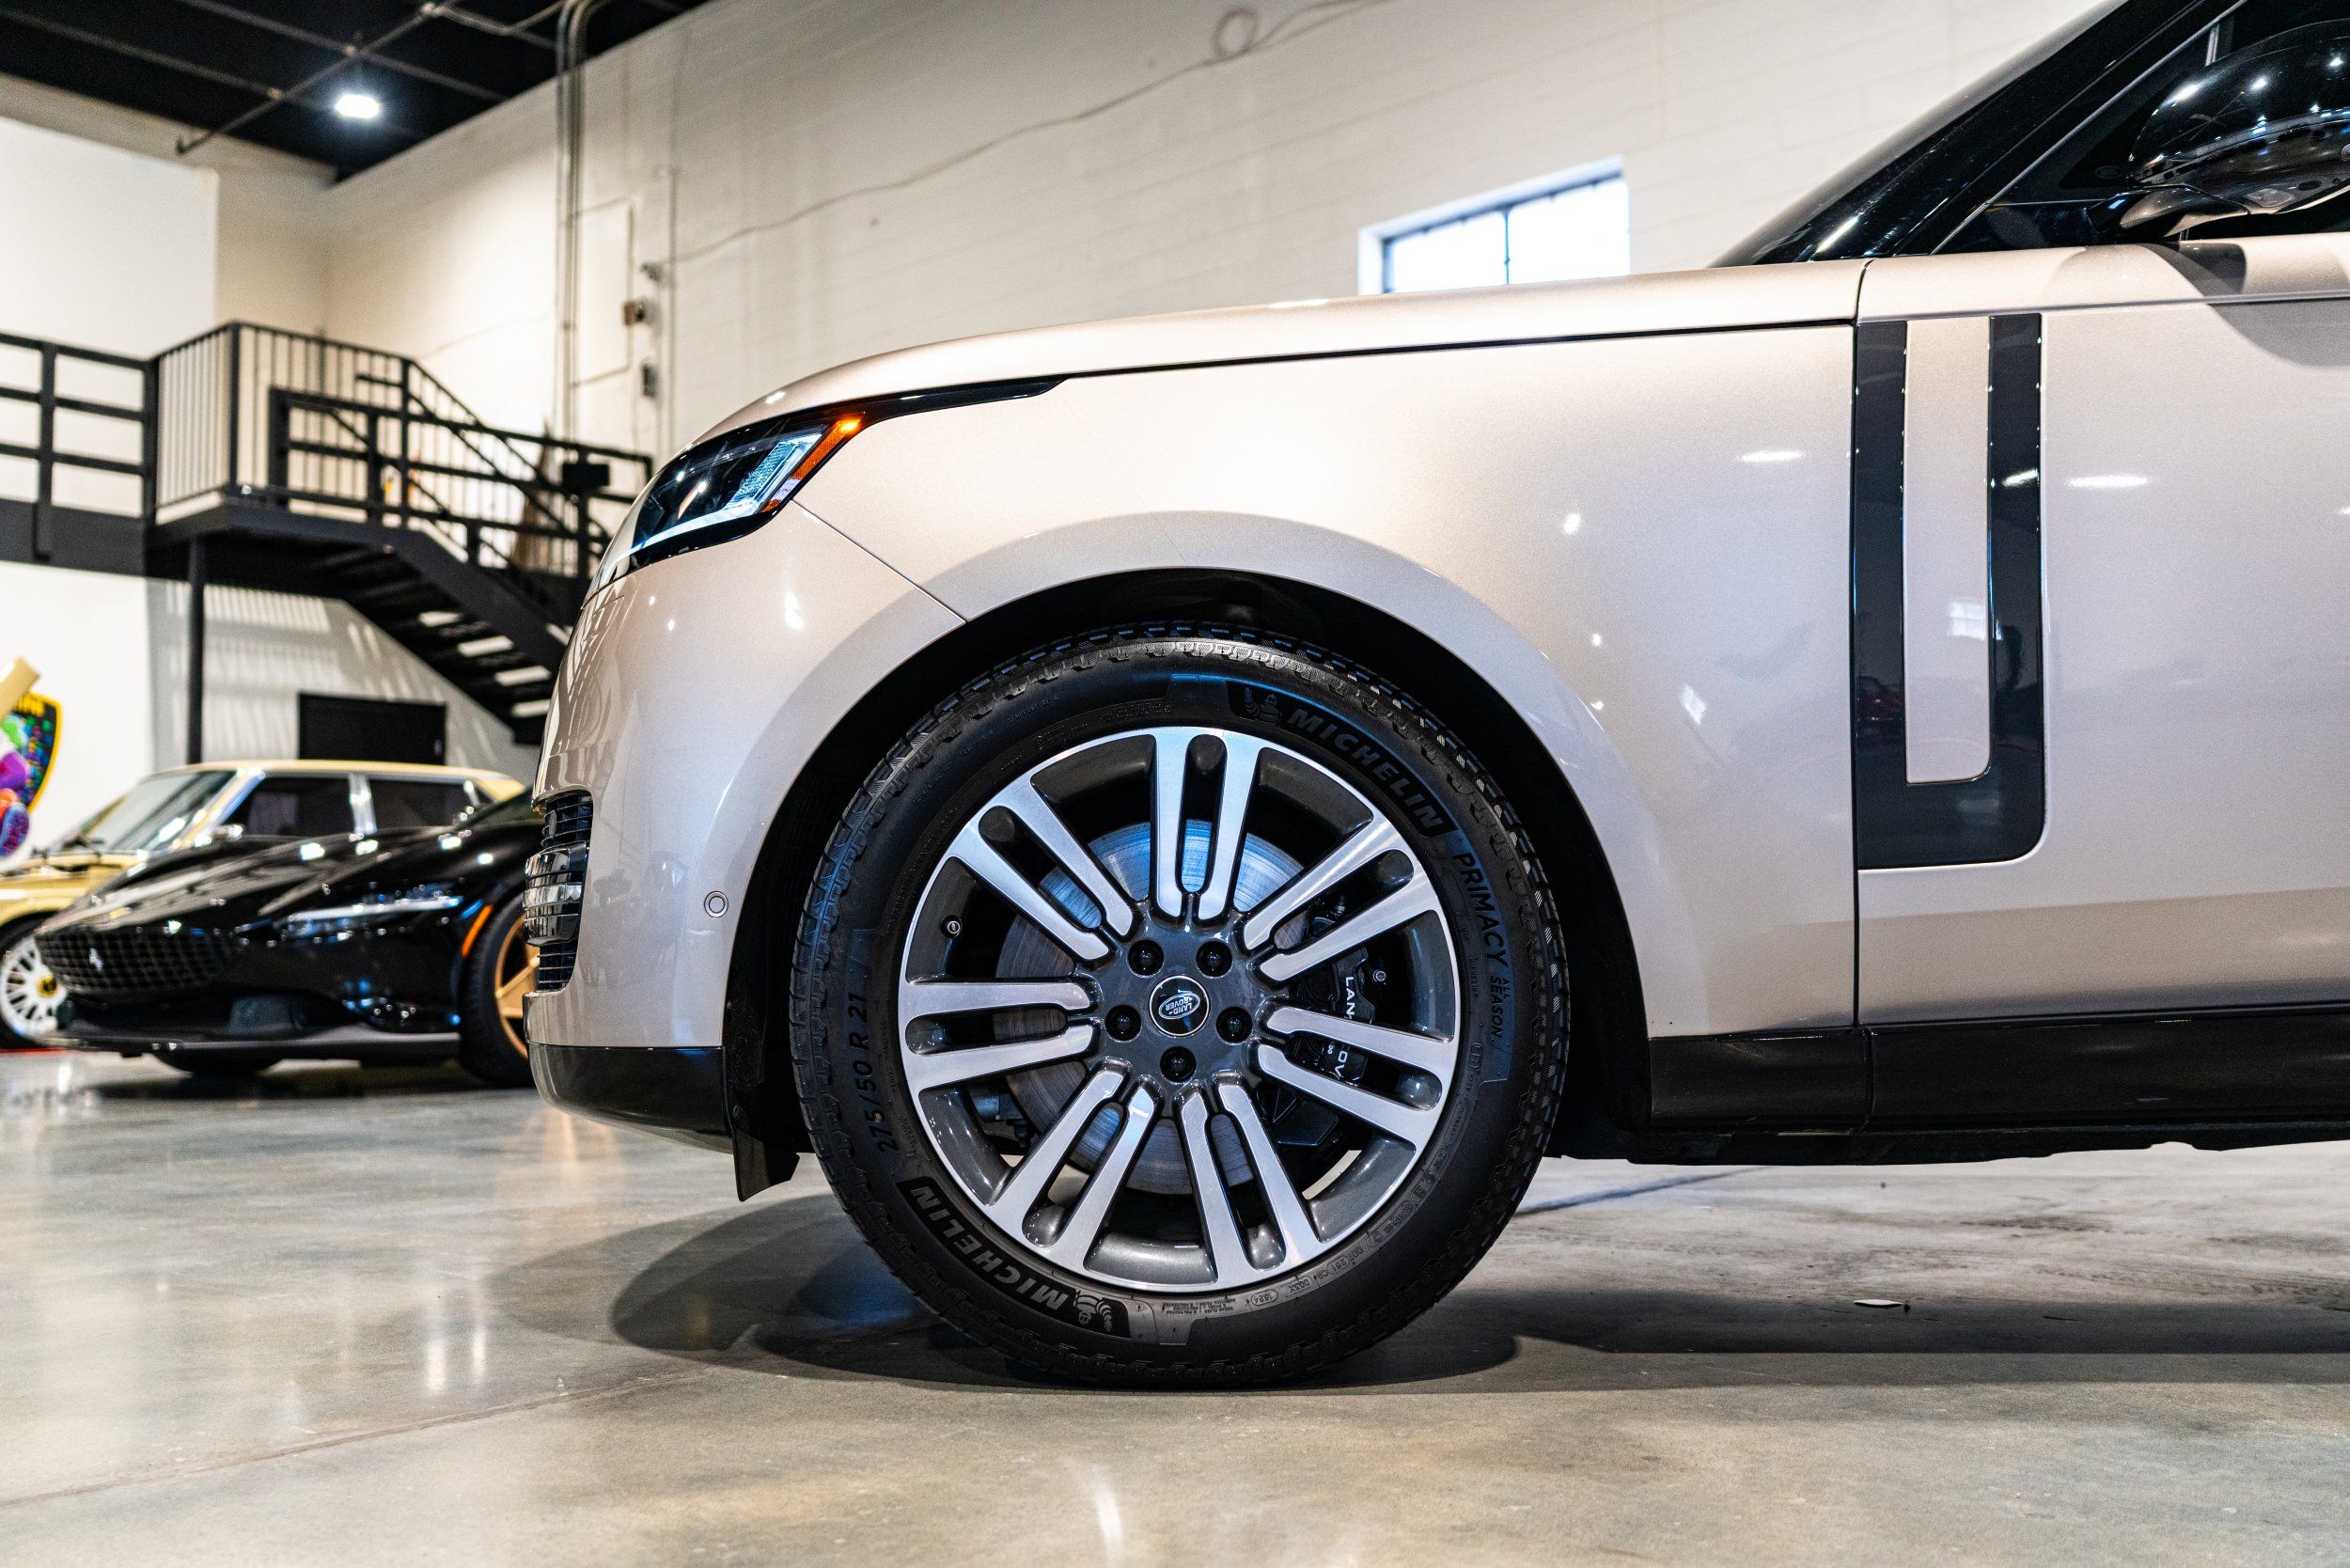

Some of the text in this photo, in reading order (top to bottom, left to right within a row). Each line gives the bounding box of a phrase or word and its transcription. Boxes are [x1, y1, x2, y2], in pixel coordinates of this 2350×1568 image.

[1287, 705, 1443, 830] MICHELIN
[1454, 852, 1509, 969] PRIMACY
[846, 991, 868, 1025] 21
[1165, 996, 1191, 1011] ROVER
[1173, 1002, 1192, 1015] LAND
[1345, 976, 1355, 1019] LAN
[1489, 976, 1504, 1039] SEASON
[1500, 976, 1512, 999] ALL
[846, 1028, 870, 1053] R
[852, 1058, 898, 1153] 275/50
[911, 1184, 1069, 1311] MICHELIN
